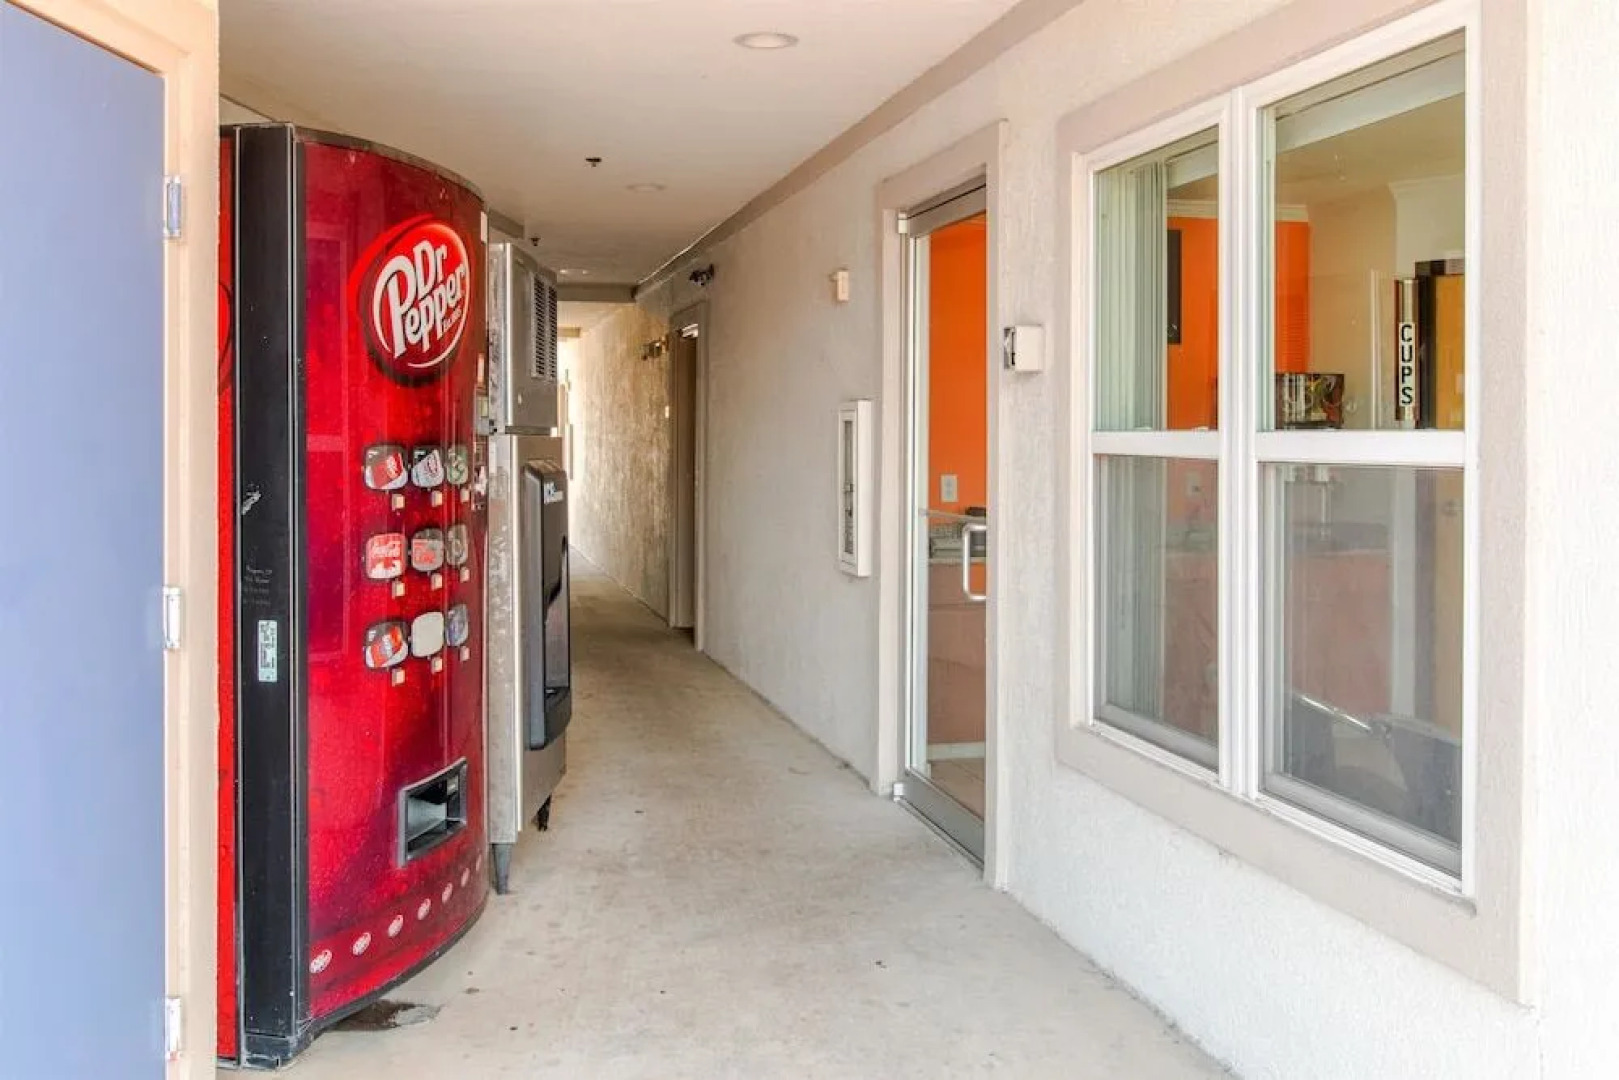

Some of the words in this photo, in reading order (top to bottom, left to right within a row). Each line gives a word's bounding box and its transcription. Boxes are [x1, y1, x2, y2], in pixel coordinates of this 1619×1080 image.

[374, 255, 466, 359] Pepper
[413, 240, 447, 300] Dr
[1401, 324, 1413, 406] CUPS
